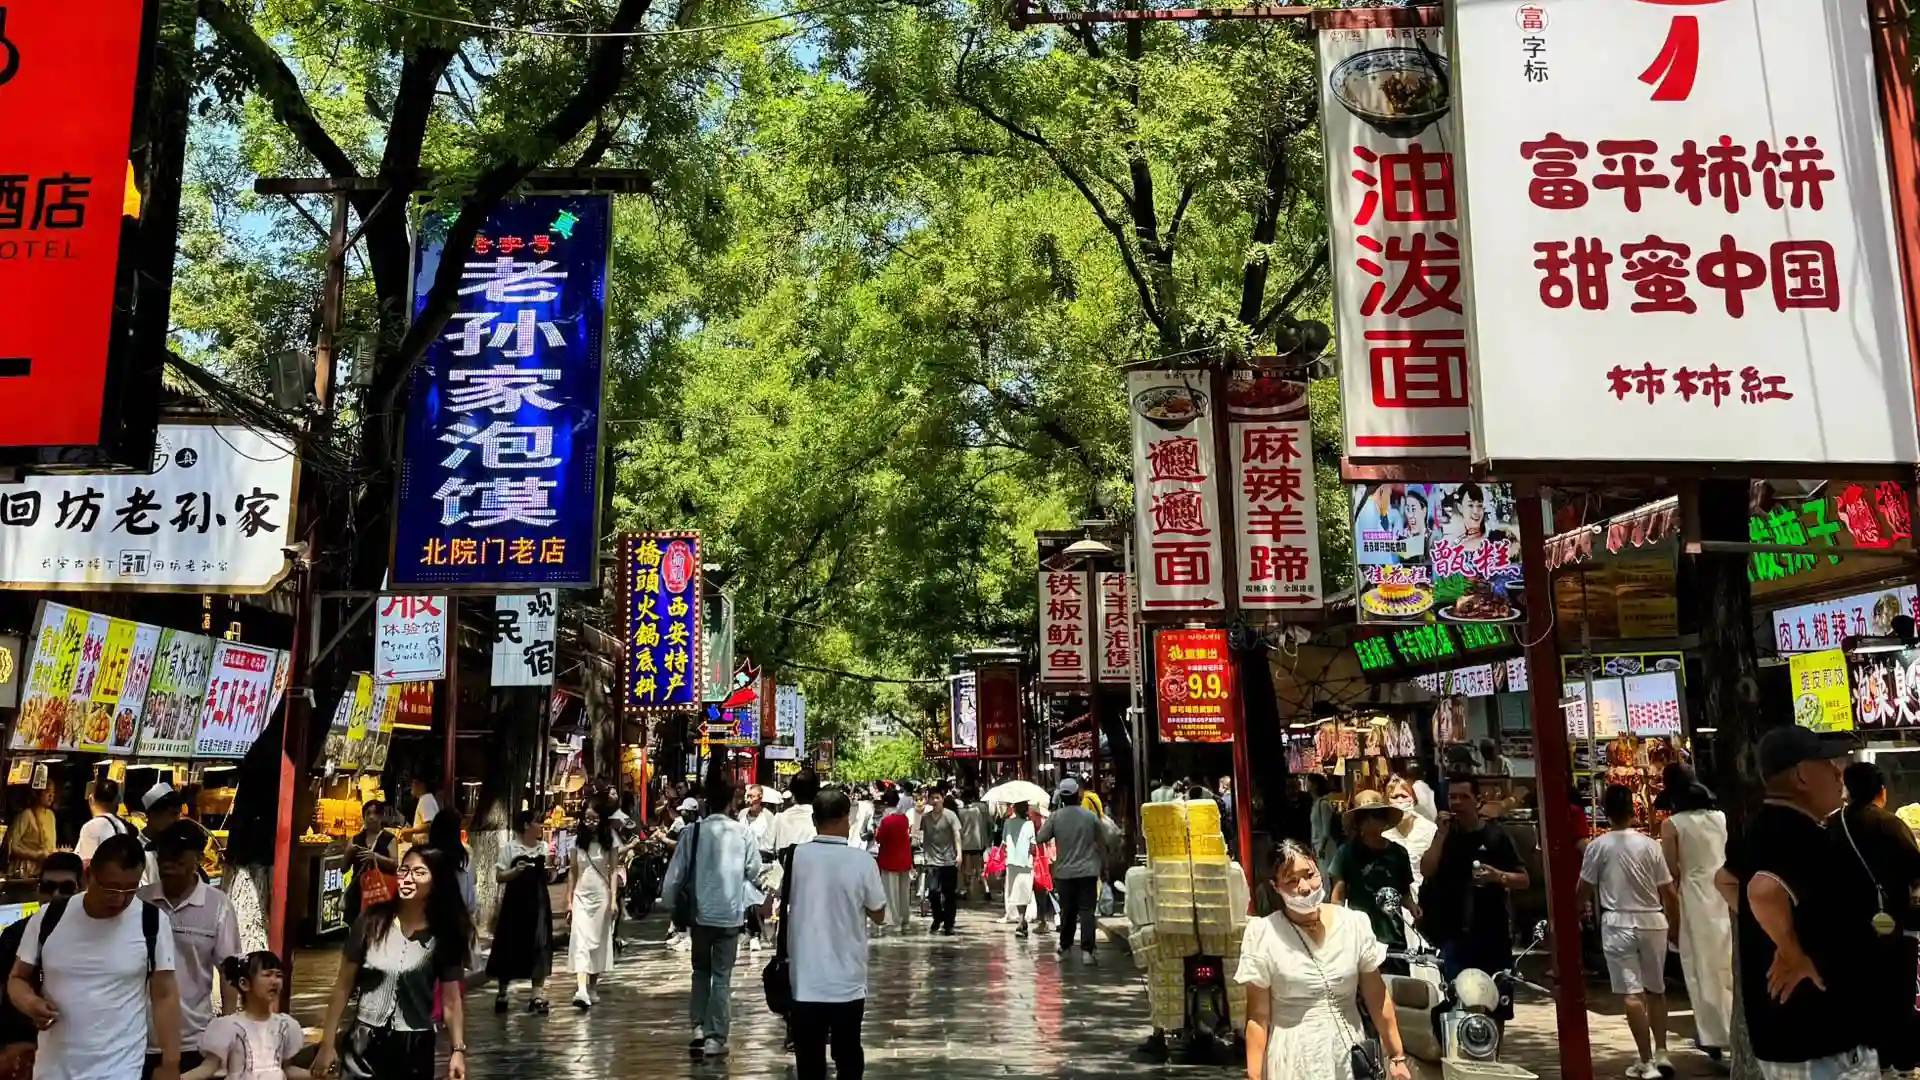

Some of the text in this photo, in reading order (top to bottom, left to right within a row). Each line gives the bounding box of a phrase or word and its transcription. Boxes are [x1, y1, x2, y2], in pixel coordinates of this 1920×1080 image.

[1520, 132, 1835, 214] 富平柿饼
[1352, 143, 1469, 408] 油泼面
[1533, 234, 1840, 318] 甜蜜中国
[432, 256, 568, 529] 老孙家泡馍
[1606, 362, 1794, 408] 柿柿紅
[1, 486, 281, 538] 回坊老孙家
[1242, 426, 1309, 583] 麻辣羊蹄
[420, 537, 566, 565] 北院门老店
[383, 621, 441, 637] 体验馆
[663, 597, 689, 701] 西安特产
[1046, 573, 1083, 671] 铁板鱿鱼
[1188, 673, 1222, 699] 9.9
